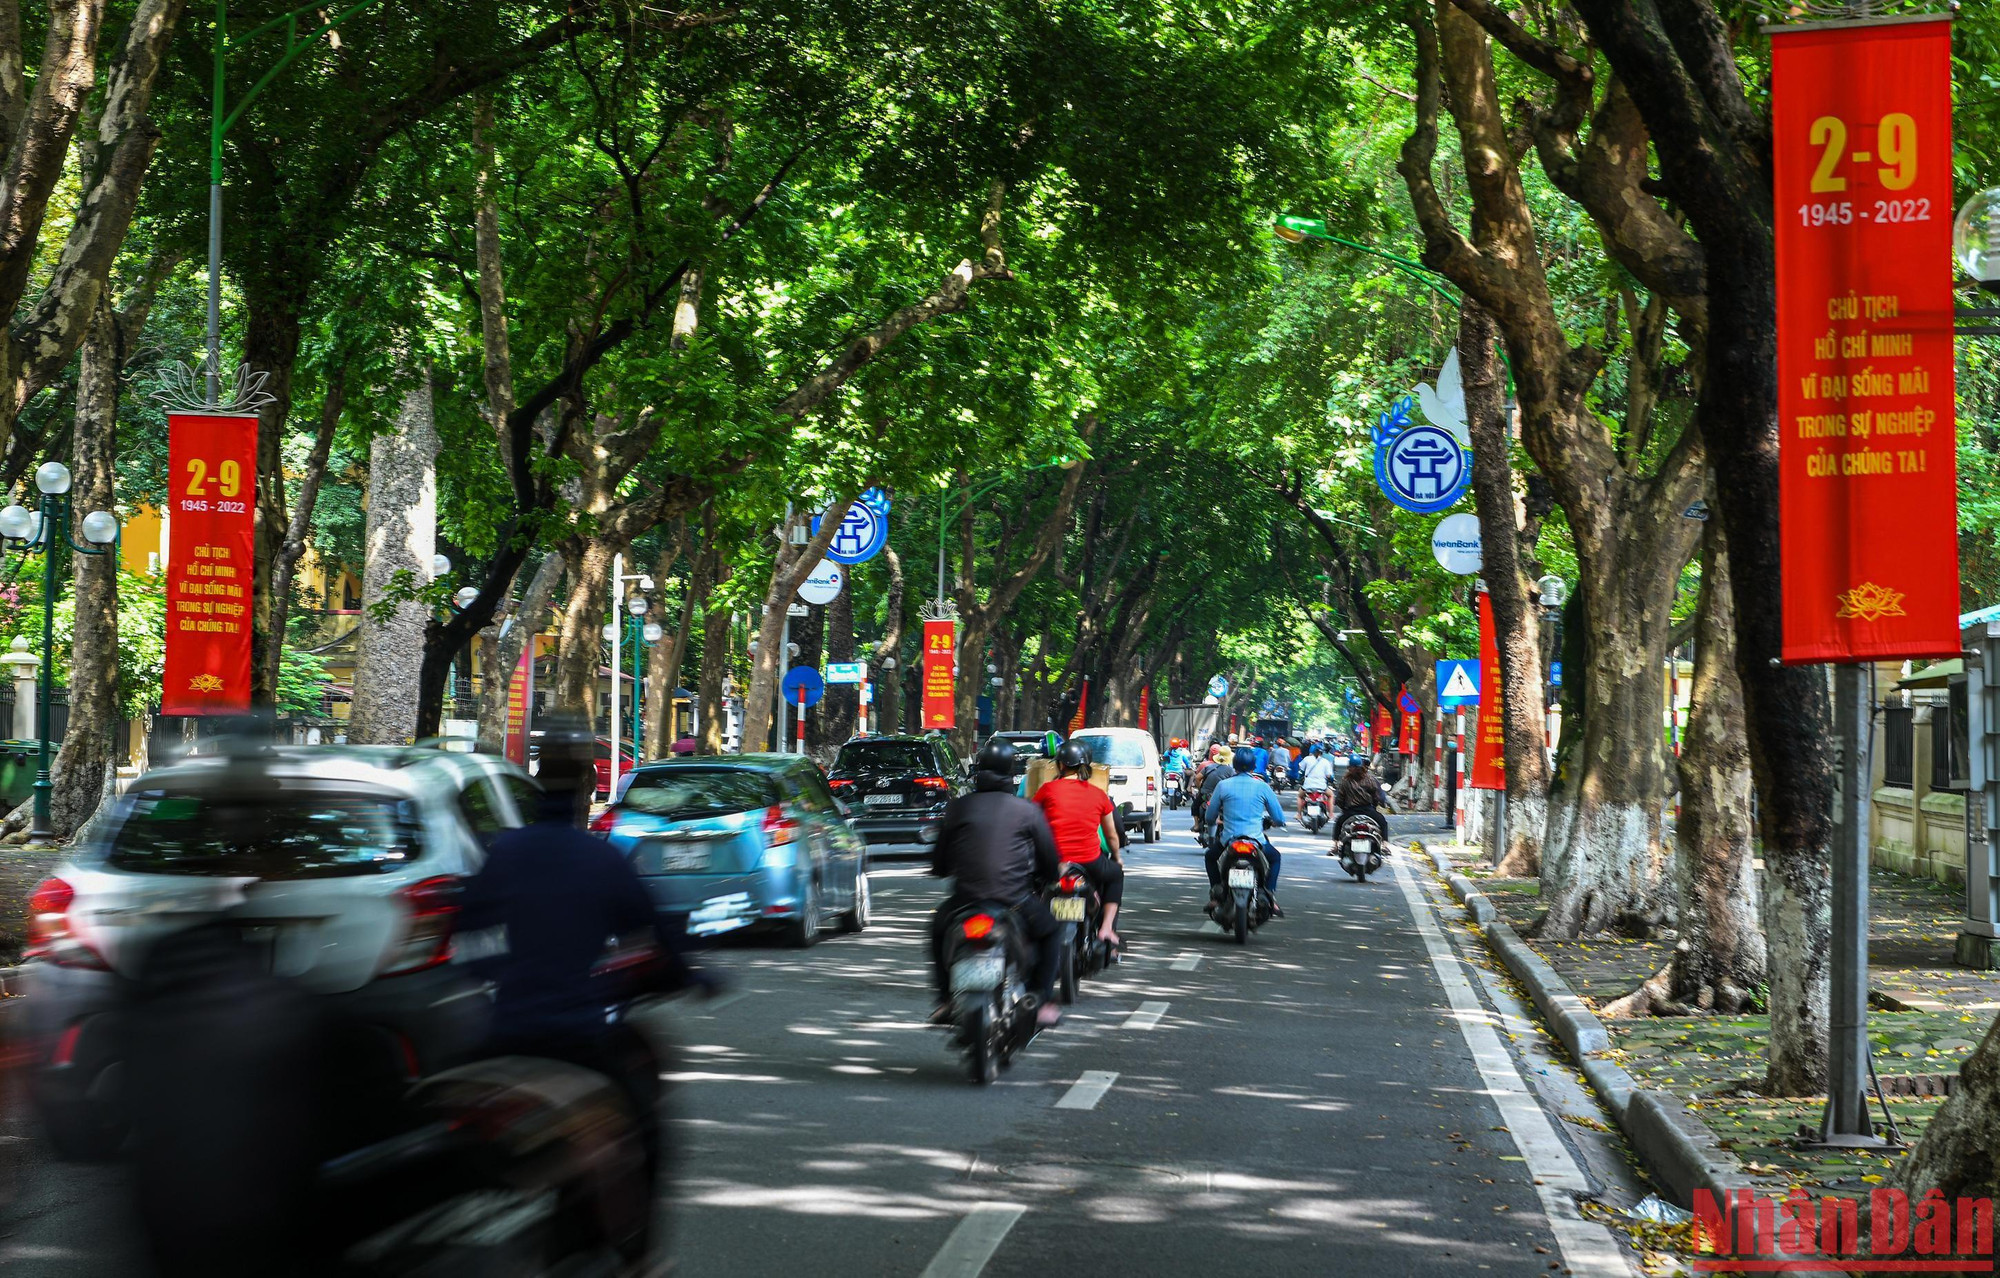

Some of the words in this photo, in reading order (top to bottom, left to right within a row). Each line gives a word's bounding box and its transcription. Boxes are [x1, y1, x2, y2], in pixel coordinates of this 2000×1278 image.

[1809, 112, 1917, 193] 2-9
[1798, 202, 1853, 226] 1945
[1874, 198, 1931, 223] 2022
[1828, 289, 1858, 320] CHỦ
[1862, 295, 1898, 322] TỊCH
[1814, 328, 1836, 360] HỒ
[1841, 329, 1867, 359] CHÍ
[1871, 334, 1913, 358] MINH
[1801, 372, 1817, 400] VĨ
[1821, 375, 1848, 402] ĐẠI
[1852, 365, 1894, 397] SỐNG
[1899, 365, 1930, 396] MÃI
[1796, 414, 1847, 439] TRONG
[1851, 409, 1872, 439] SỰ
[1875, 405, 1936, 438] NGHIỆP
[1806, 446, 1838, 478] CỦA
[1842, 446, 1894, 476] CHÚNG
[186, 458, 240, 497] 2-9
[180, 499, 208, 512] 1945
[217, 501, 246, 514] 2022
[194, 543, 210, 558] CHỦ
[212, 547, 231, 560] TỊCH
[187, 561, 199, 576] HỒ
[200, 563, 213, 577] CHÍ
[215, 565, 237, 578] MINH
[204, 580, 226, 595] SỐNG
[176, 601, 201, 613] TRONG
[203, 601, 215, 615] SỰ
[215, 603, 245, 618] NGHIỆP
[180, 616, 196, 631] CỦA
[197, 618, 223, 632] CHÚNG
[930, 634, 951, 649] 2-9
